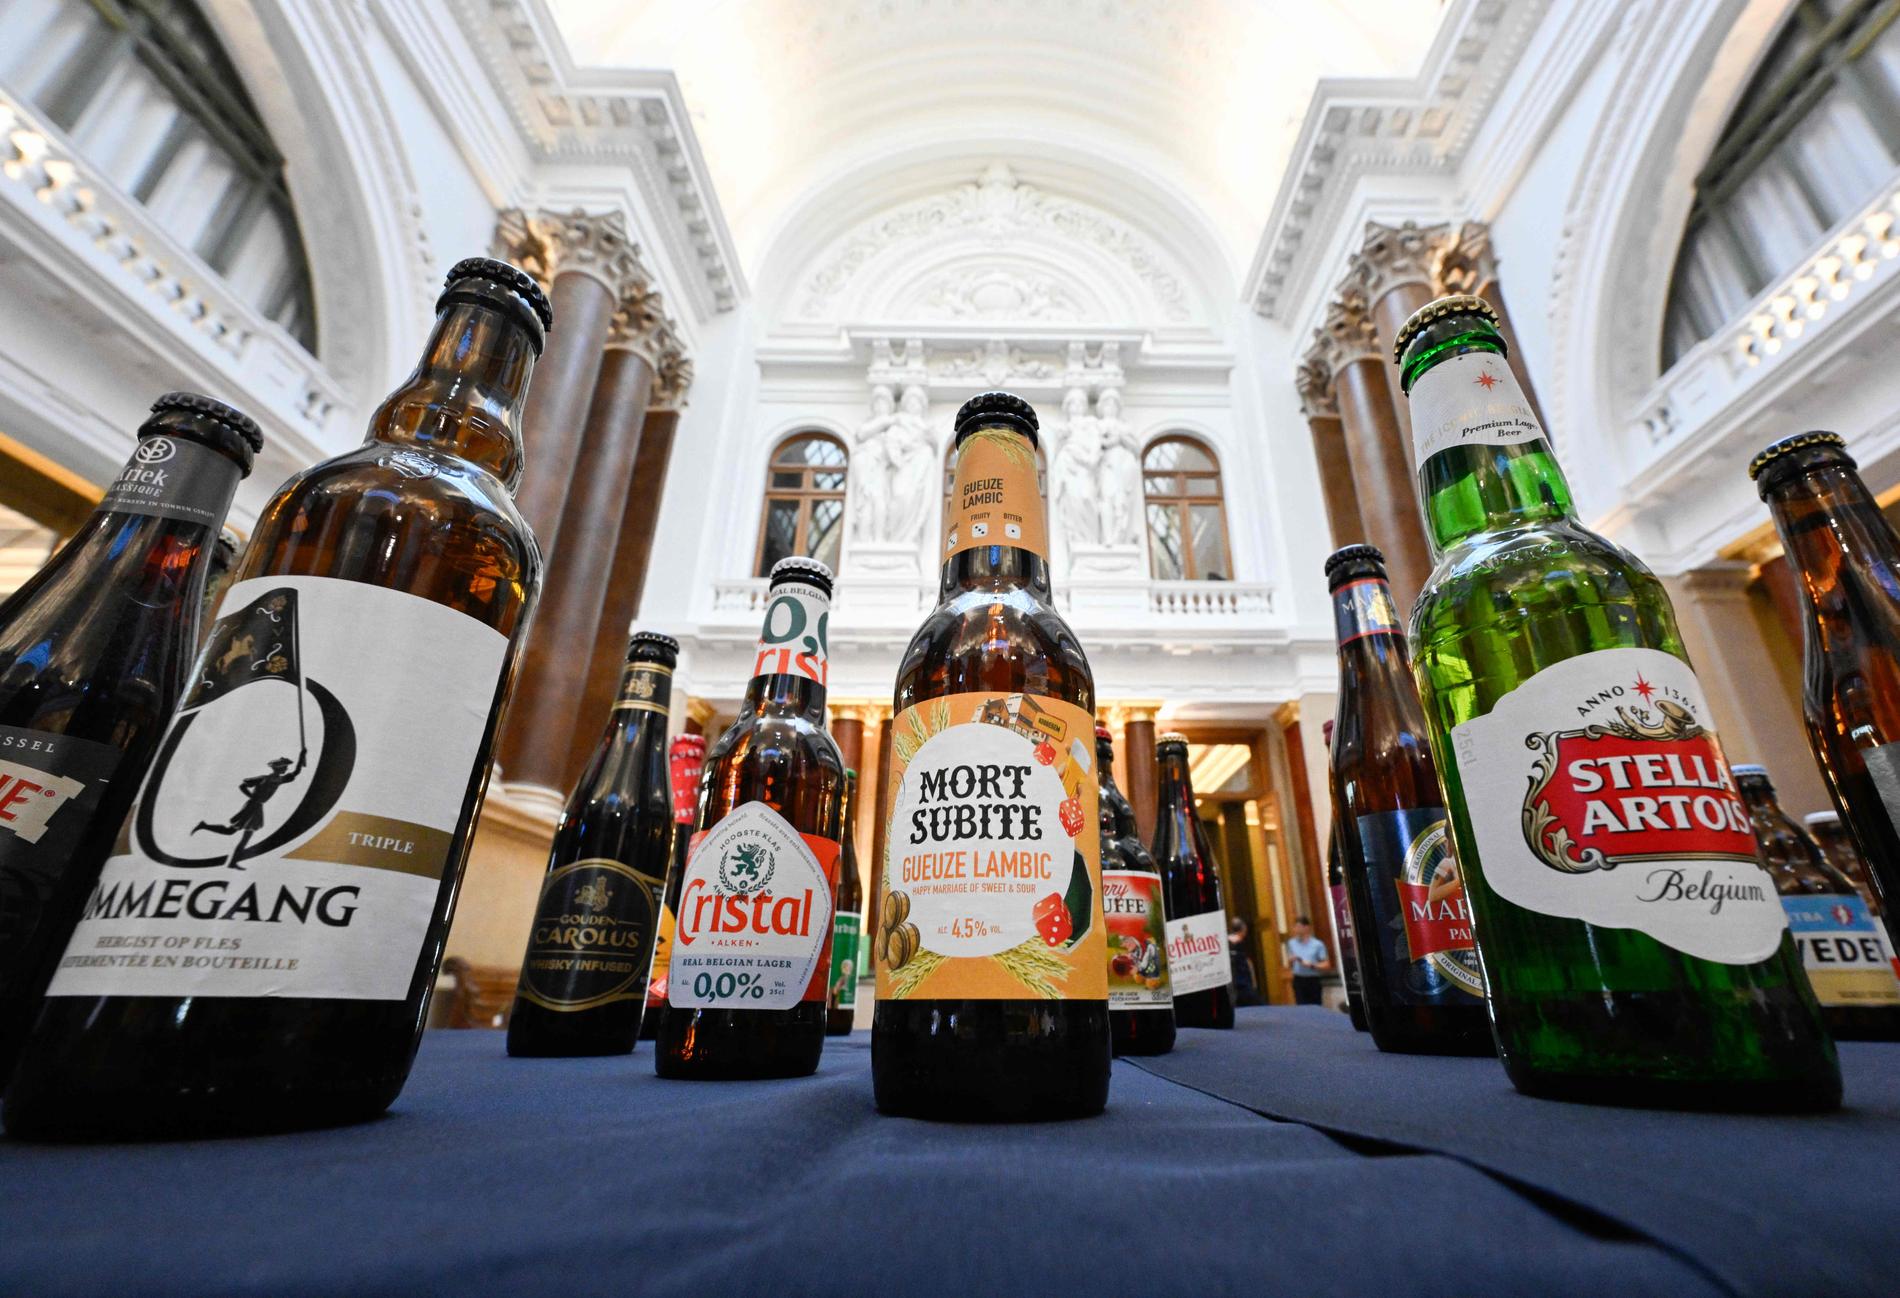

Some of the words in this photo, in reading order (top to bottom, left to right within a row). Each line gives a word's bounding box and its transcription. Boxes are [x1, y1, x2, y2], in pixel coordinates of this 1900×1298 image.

[1462, 420, 1513, 439] Premium
[1497, 429, 1522, 438] Beer
[120, 465, 169, 487] riek
[964, 478, 1004, 496] GUEUZE
[962, 491, 1003, 510] LAMBIC
[970, 512, 991, 522] FRUITY
[1003, 512, 1023, 523] BITTER
[1577, 685, 1625, 718] ANNO
[1664, 686, 1698, 714] 1366
[0, 733, 55, 753] SSEL
[1455, 727, 1478, 768] 25cl
[1567, 753, 1737, 794] STELLA
[919, 765, 1032, 805] MORT
[910, 804, 1043, 845] SUBITE
[1582, 795, 1751, 836] ARTOIS
[348, 831, 415, 855] TRIPLE
[720, 829, 760, 851] HOOGSTE
[762, 833, 782, 853] KLAS
[902, 851, 967, 883] GUEUZE
[973, 850, 1052, 880] LAMBIC
[912, 886, 931, 896] HAPPY
[932, 884, 968, 895] MARRIAGE
[970, 883, 980, 893] OF
[981, 882, 1007, 893] SWEET
[1016, 883, 1036, 894] SOUR
[1636, 867, 1766, 915] Belgium
[82, 879, 362, 928] MMEGANG
[678, 878, 814, 946] Cristal
[559, 914, 618, 926] GOUDEN
[952, 917, 987, 938] 4.5%
[163, 936, 191, 950] OP
[193, 937, 242, 951] FLES
[535, 926, 640, 950] CAROLUS
[716, 939, 753, 947] ALKEN
[152, 955, 180, 969] EN
[182, 955, 299, 971] BOUTEILLE
[576, 958, 632, 973] INFUSED
[682, 958, 703, 967] REAL
[706, 958, 753, 967] BELGIAN
[757, 959, 792, 969] LAGER
[694, 972, 764, 1002] 0,0%
